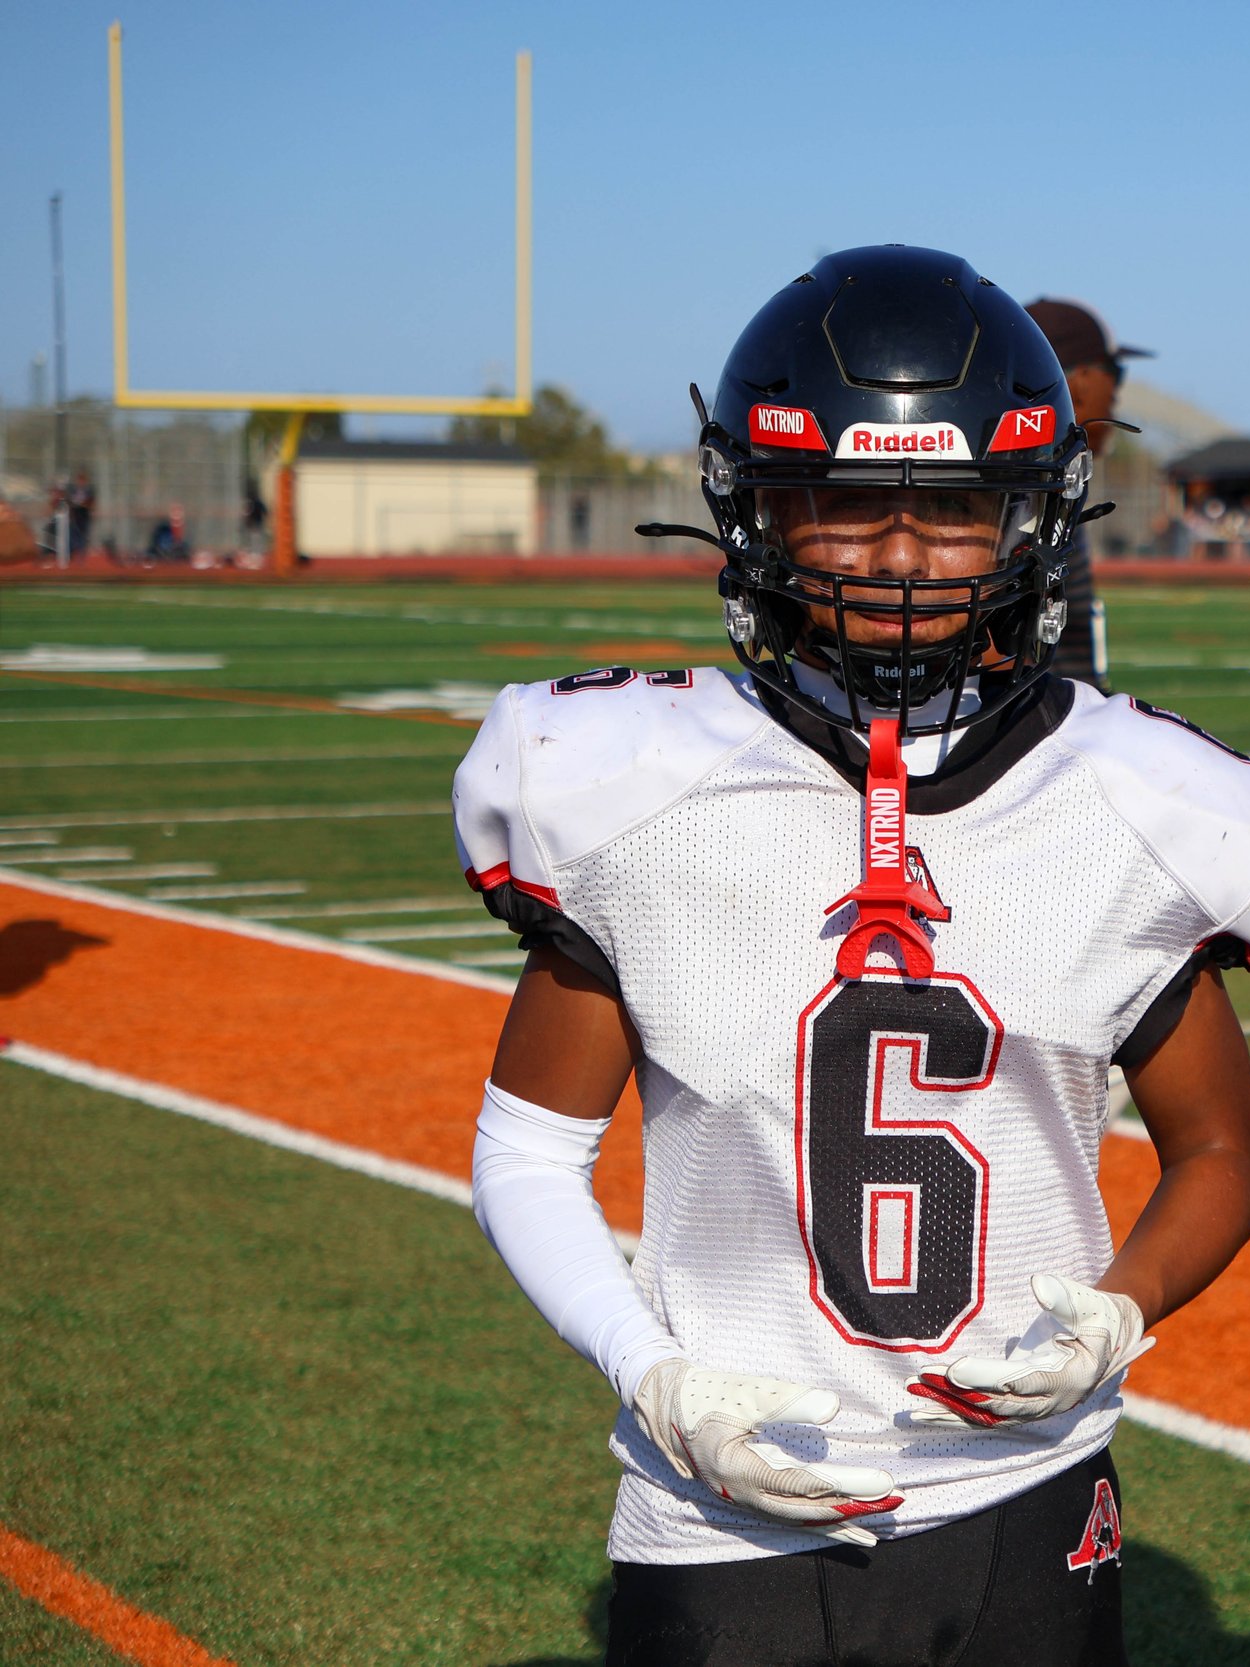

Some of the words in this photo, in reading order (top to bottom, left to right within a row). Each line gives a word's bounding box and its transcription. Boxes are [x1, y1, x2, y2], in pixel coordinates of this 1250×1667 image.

[758, 408, 804, 434] NXTRND
[853, 430, 954, 452] Riddell
[870, 787, 900, 868] NXTRND
[795, 966, 1004, 1354] 6
